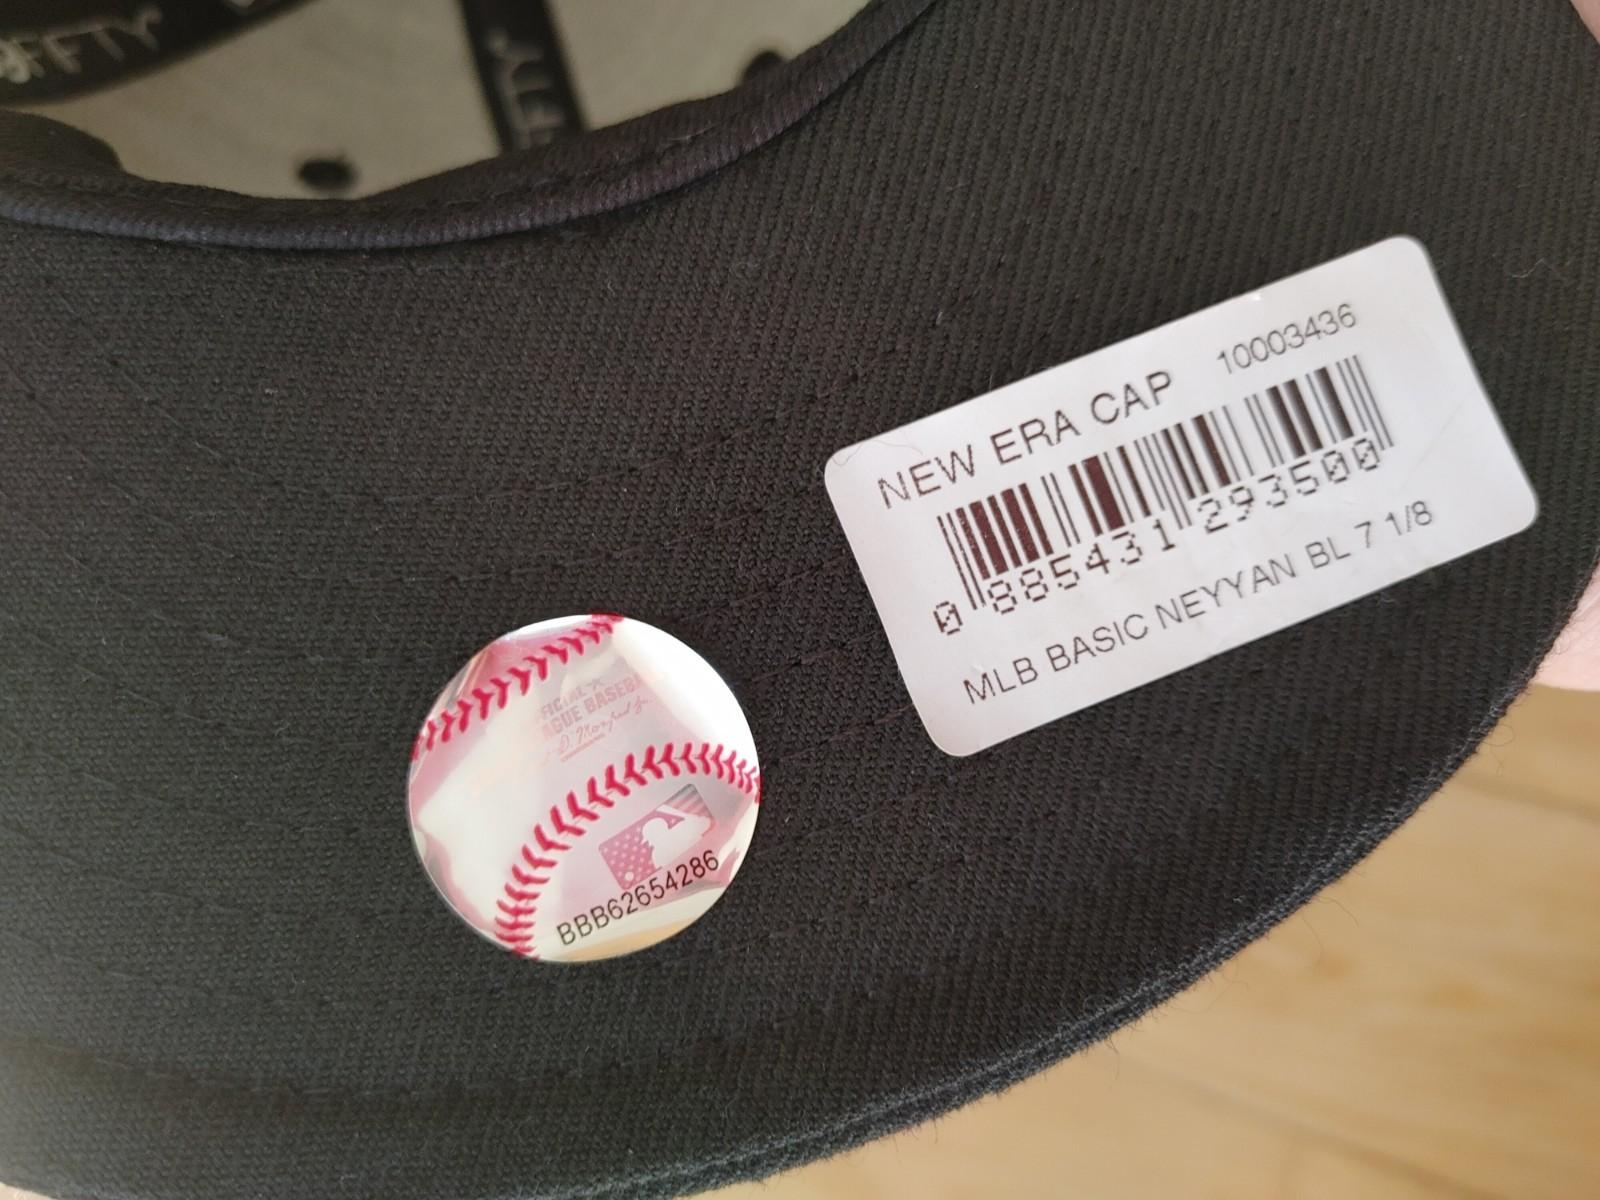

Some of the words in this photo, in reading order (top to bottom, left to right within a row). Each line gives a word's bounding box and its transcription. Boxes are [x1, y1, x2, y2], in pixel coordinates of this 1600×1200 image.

[1216, 303, 1357, 375] 10003436
[877, 443, 976, 510] NEW
[989, 409, 1081, 466] ERA
[1090, 370, 1173, 425] CAP
[963, 656, 1039, 705] MLB
[1045, 612, 1150, 673] BASIC
[1154, 553, 1297, 630] NEYYAN
[1304, 536, 1352, 570] BL
[1353, 520, 1372, 549] 7
[1384, 499, 1434, 537] 1/8
[556, 849, 719, 946] BBB62654286
